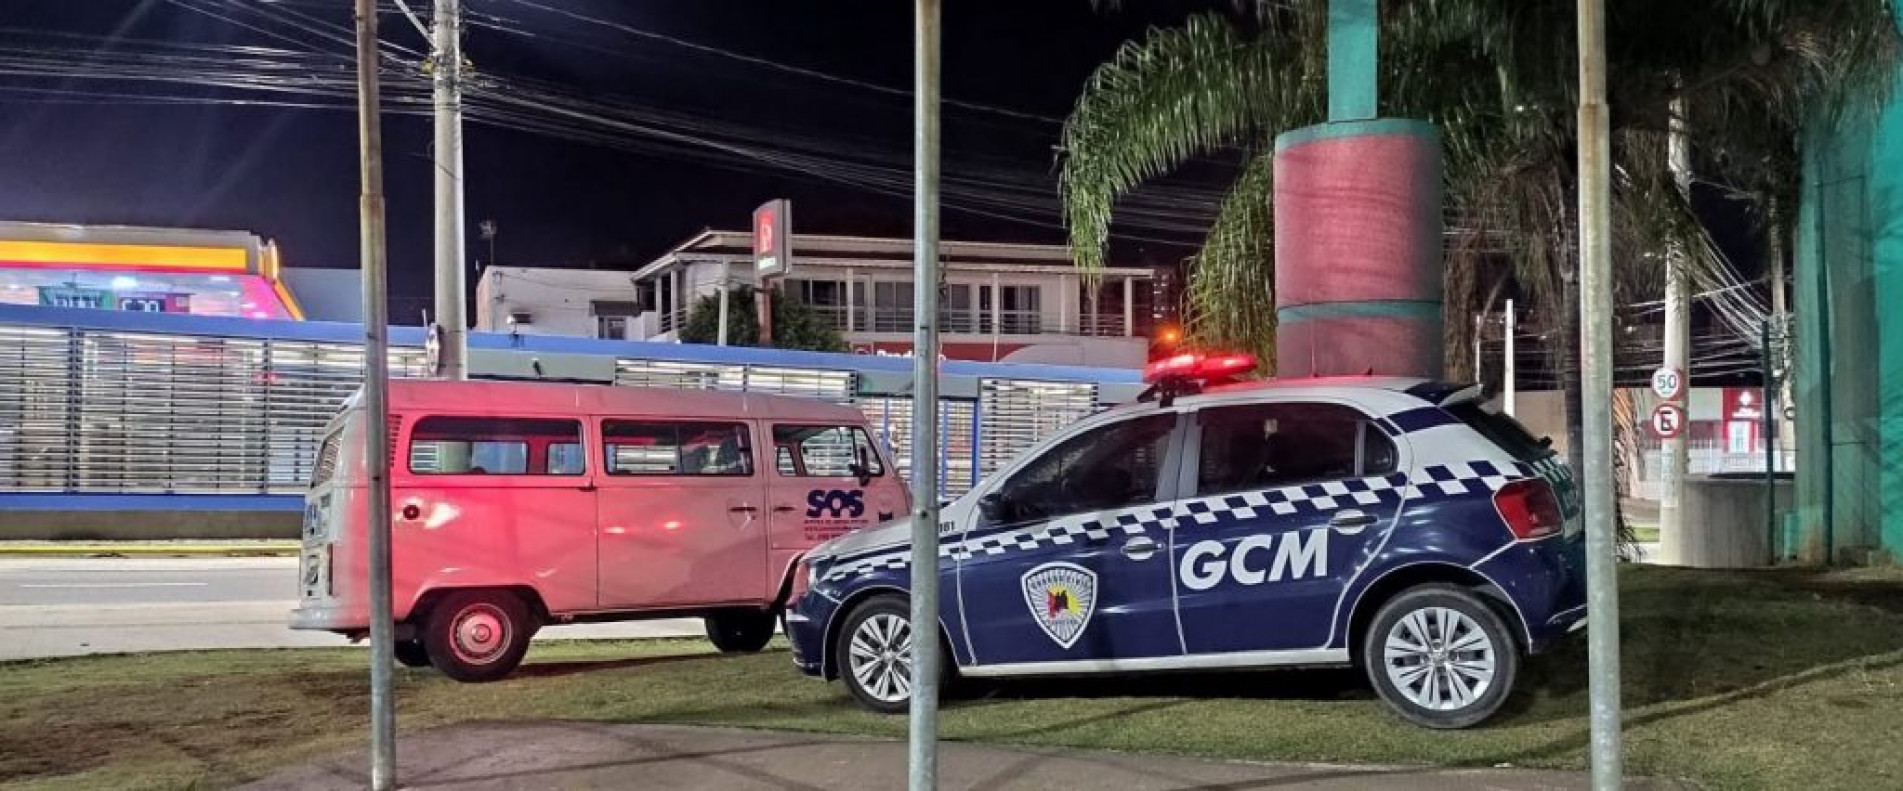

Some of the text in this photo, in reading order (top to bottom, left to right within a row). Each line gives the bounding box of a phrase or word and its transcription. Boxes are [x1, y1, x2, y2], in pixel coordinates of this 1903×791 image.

[1658, 375, 1676, 388] 50
[806, 489, 864, 519] SOS
[1180, 529, 1328, 590] GCM
